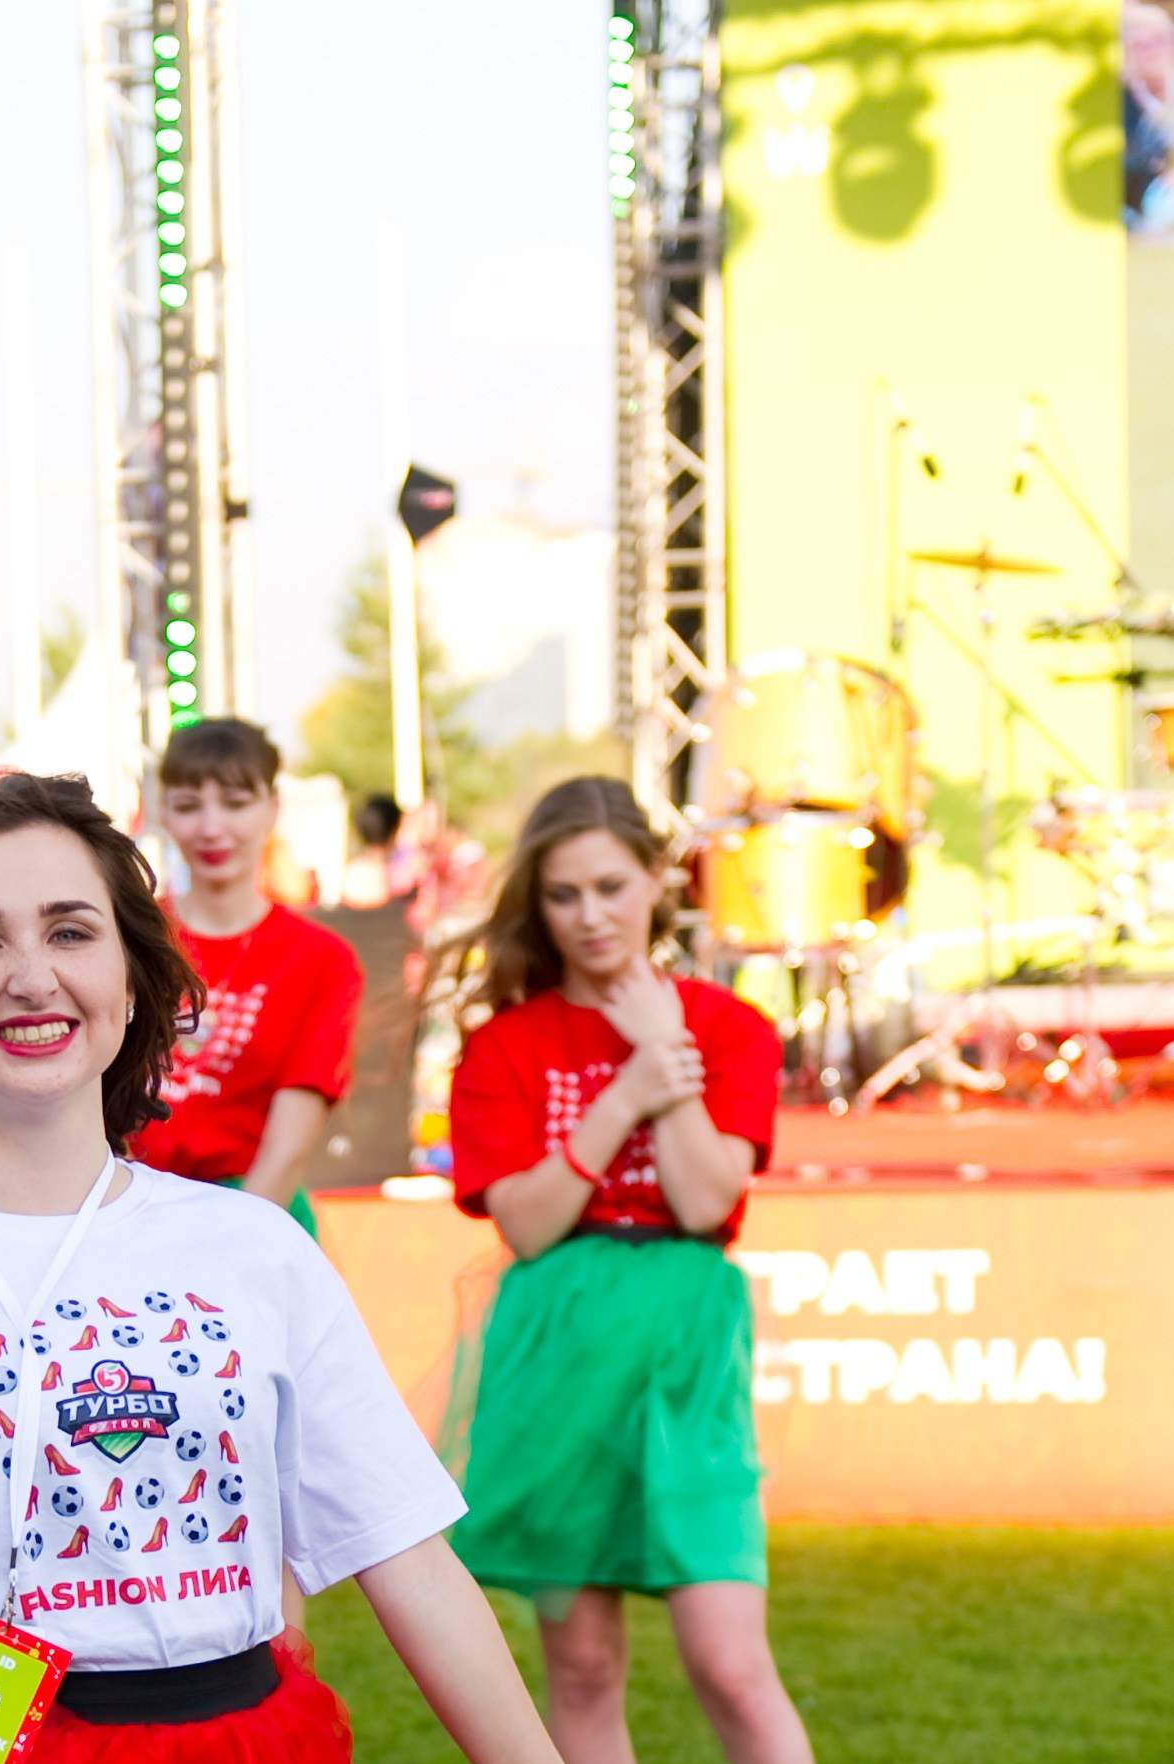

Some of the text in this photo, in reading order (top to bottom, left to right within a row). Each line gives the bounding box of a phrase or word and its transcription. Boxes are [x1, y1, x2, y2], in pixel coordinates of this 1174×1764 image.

[63, 1394, 172, 1421] ТУРБО
[88, 1419, 151, 1433] ФУТБОЛ
[19, 1565, 252, 1620] FASHION ЛИГА
[0, 1652, 16, 1670] ID
